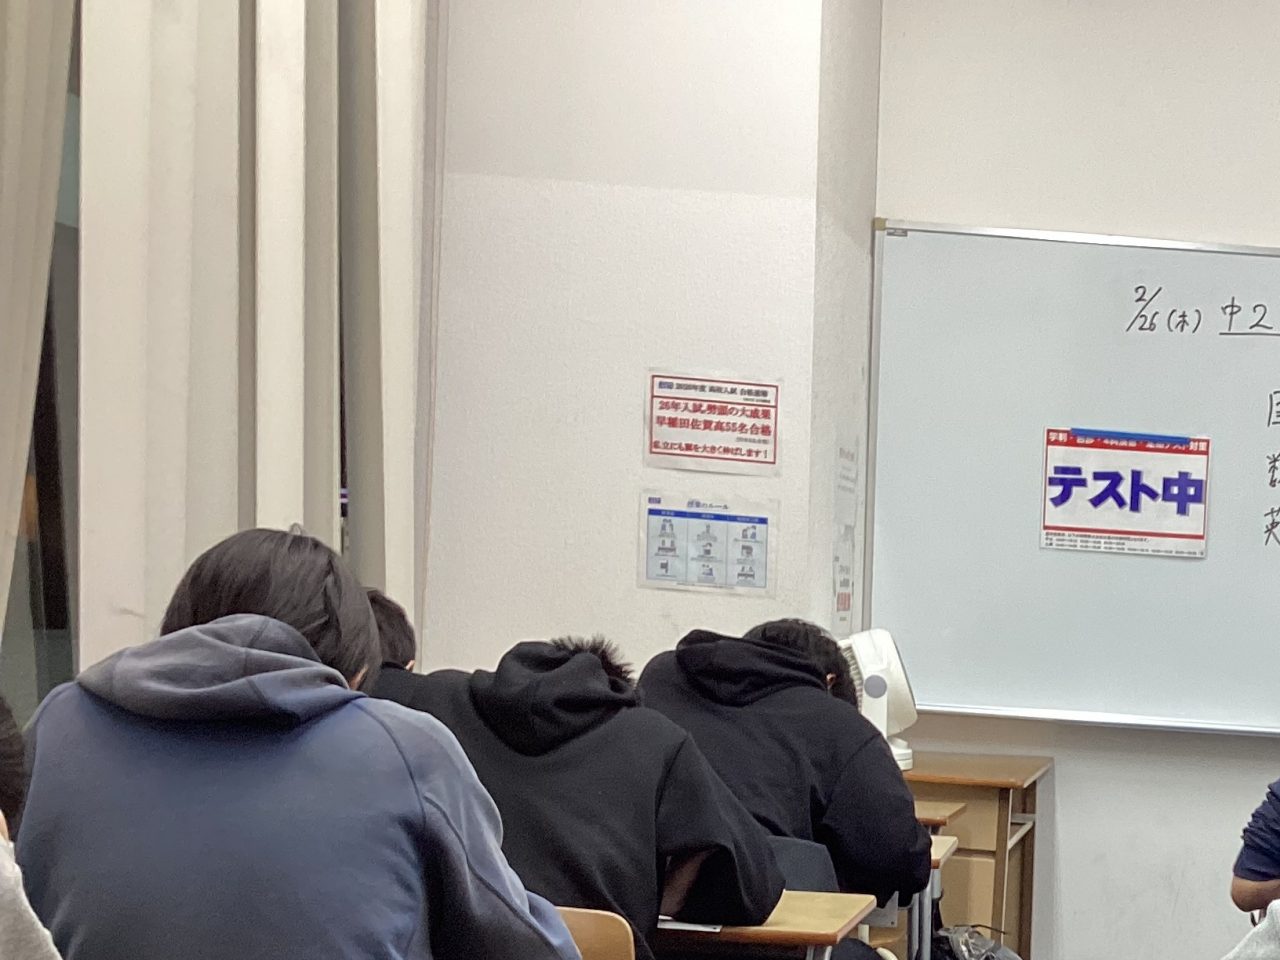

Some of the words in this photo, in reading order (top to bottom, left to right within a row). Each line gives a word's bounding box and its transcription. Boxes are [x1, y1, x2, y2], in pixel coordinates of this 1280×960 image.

[1221, 296, 1274, 332] 中2
[1047, 465, 1205, 517] テスト中
